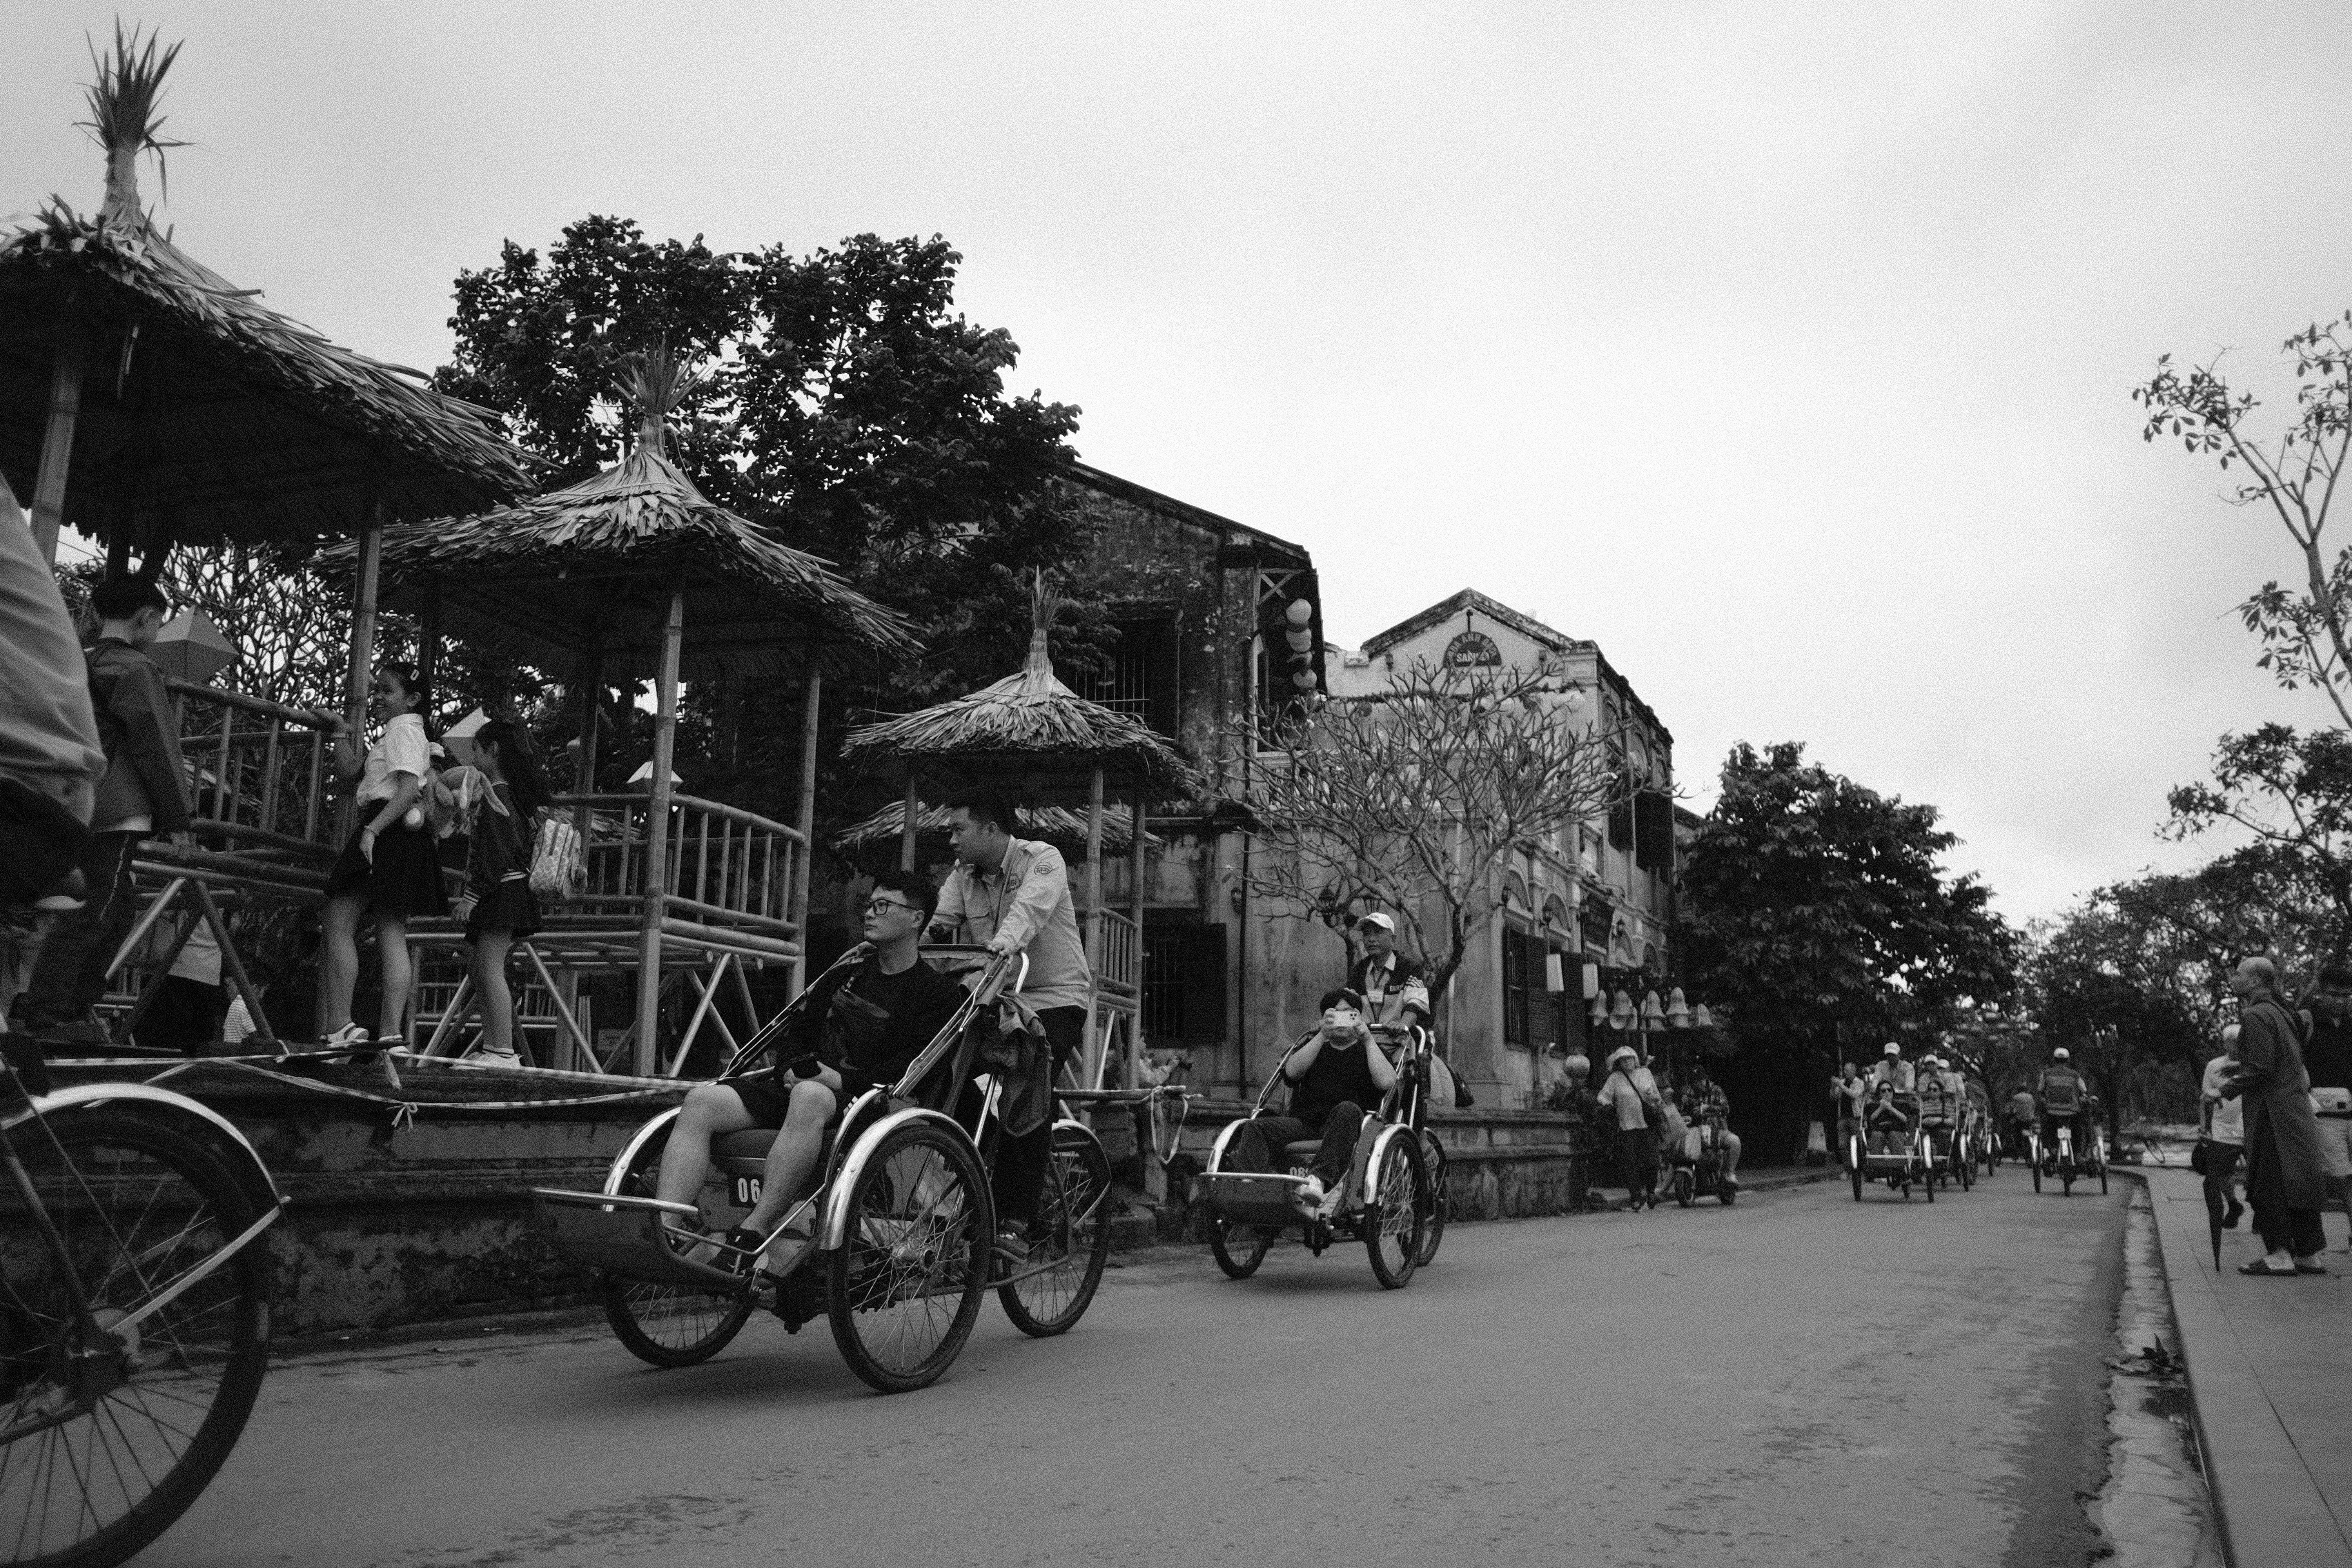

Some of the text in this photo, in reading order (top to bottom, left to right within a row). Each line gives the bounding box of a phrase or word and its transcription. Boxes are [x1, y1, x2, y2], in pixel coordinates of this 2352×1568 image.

[1461, 633, 1481, 644] ANH
[1289, 1167, 1309, 1178] 08
[738, 1178, 761, 1203] 06
